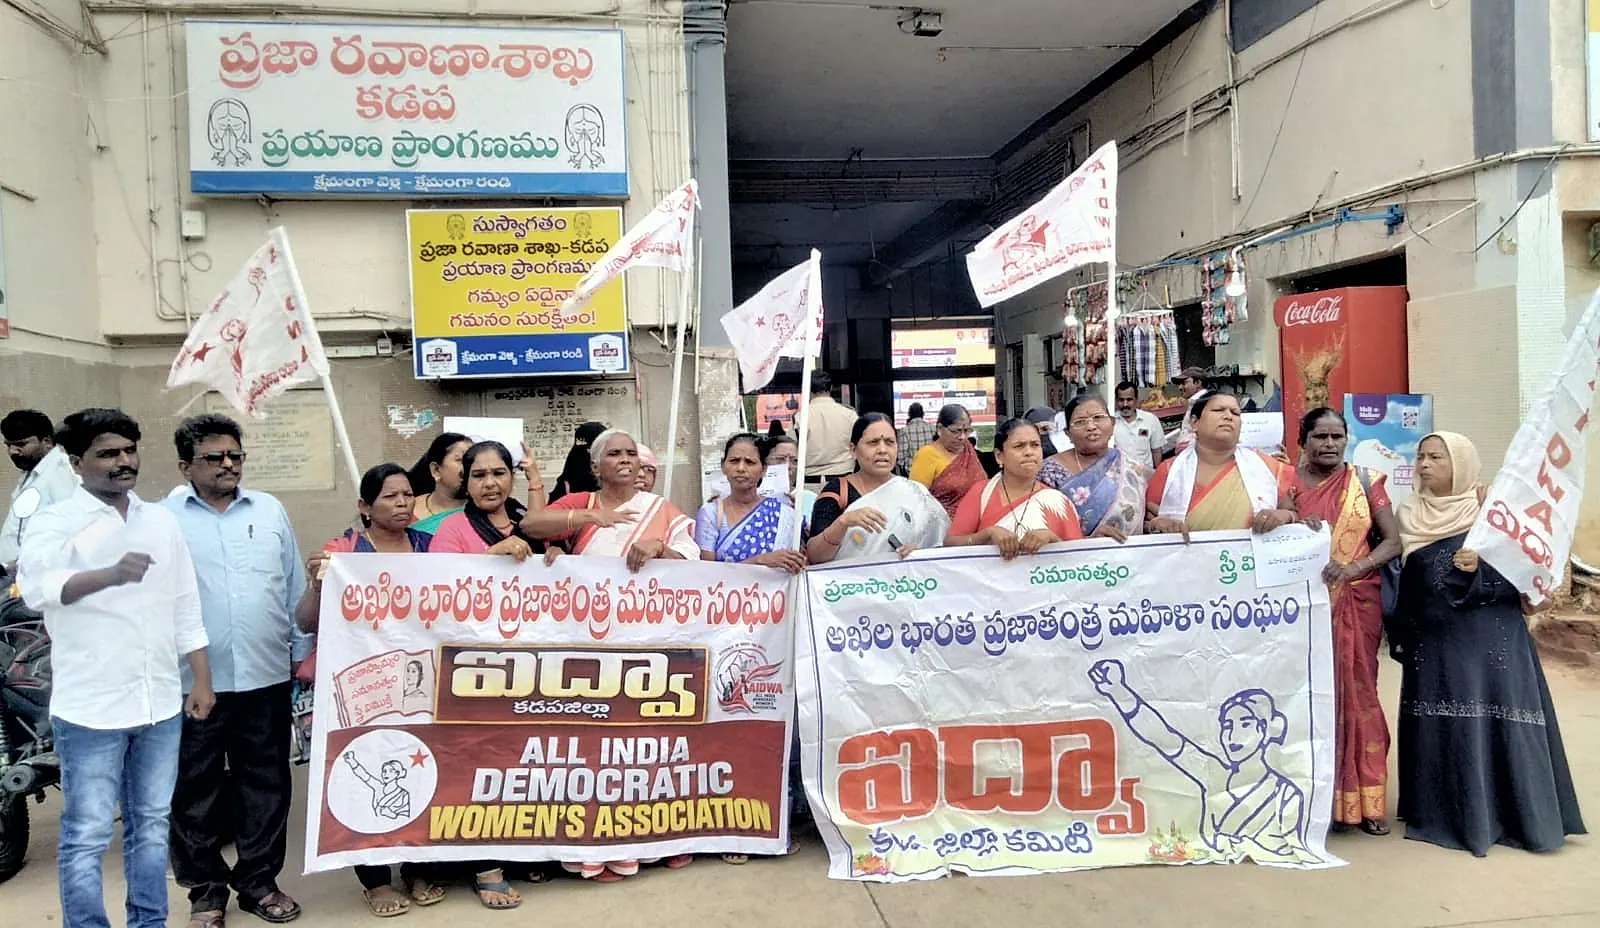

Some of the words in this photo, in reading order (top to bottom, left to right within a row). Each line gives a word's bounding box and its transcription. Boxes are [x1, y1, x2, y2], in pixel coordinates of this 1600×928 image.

[219, 31, 318, 89] ప్రజా
[356, 83, 456, 120] కడప
[262, 129, 382, 168] ప్రయాణ
[391, 129, 559, 168] ప్రాంగణము
[472, 215, 567, 238] సుస్వాగతం
[419, 241, 457, 261] ప్రజా
[461, 240, 519, 257] రవాణా
[442, 260, 506, 281] ప్రయాణ
[510, 258, 597, 280] ప్రాంగణమ
[467, 288, 520, 308] గమ్యం
[1284, 296, 1343, 327] Coca-Cola
[450, 313, 511, 329] గమనం
[1030, 562, 1129, 587] సమానత్వం
[341, 572, 412, 631] అఖిల
[418, 576, 493, 630] భారత
[498, 576, 612, 639] ప్రజాతంత్ర
[616, 577, 702, 623] మహిళా
[706, 581, 785, 633] సంఘం
[826, 615, 895, 658] అఖిల
[900, 611, 976, 654] భారత
[983, 606, 1103, 656] ప్రజాతంత్ర
[1108, 598, 1205, 636] మహిళా
[1210, 593, 1300, 633] సంఘం
[451, 650, 696, 717] ఐద్వా
[748, 682, 783, 694] AIDWA
[520, 736, 587, 765] ALL
[600, 736, 690, 765] INDIA
[471, 761, 734, 802] DEMOCRATIC
[837, 718, 1147, 836] ఐద్వా
[428, 804, 586, 840] WOMEN'S
[591, 797, 773, 839] ASSOCIATION
